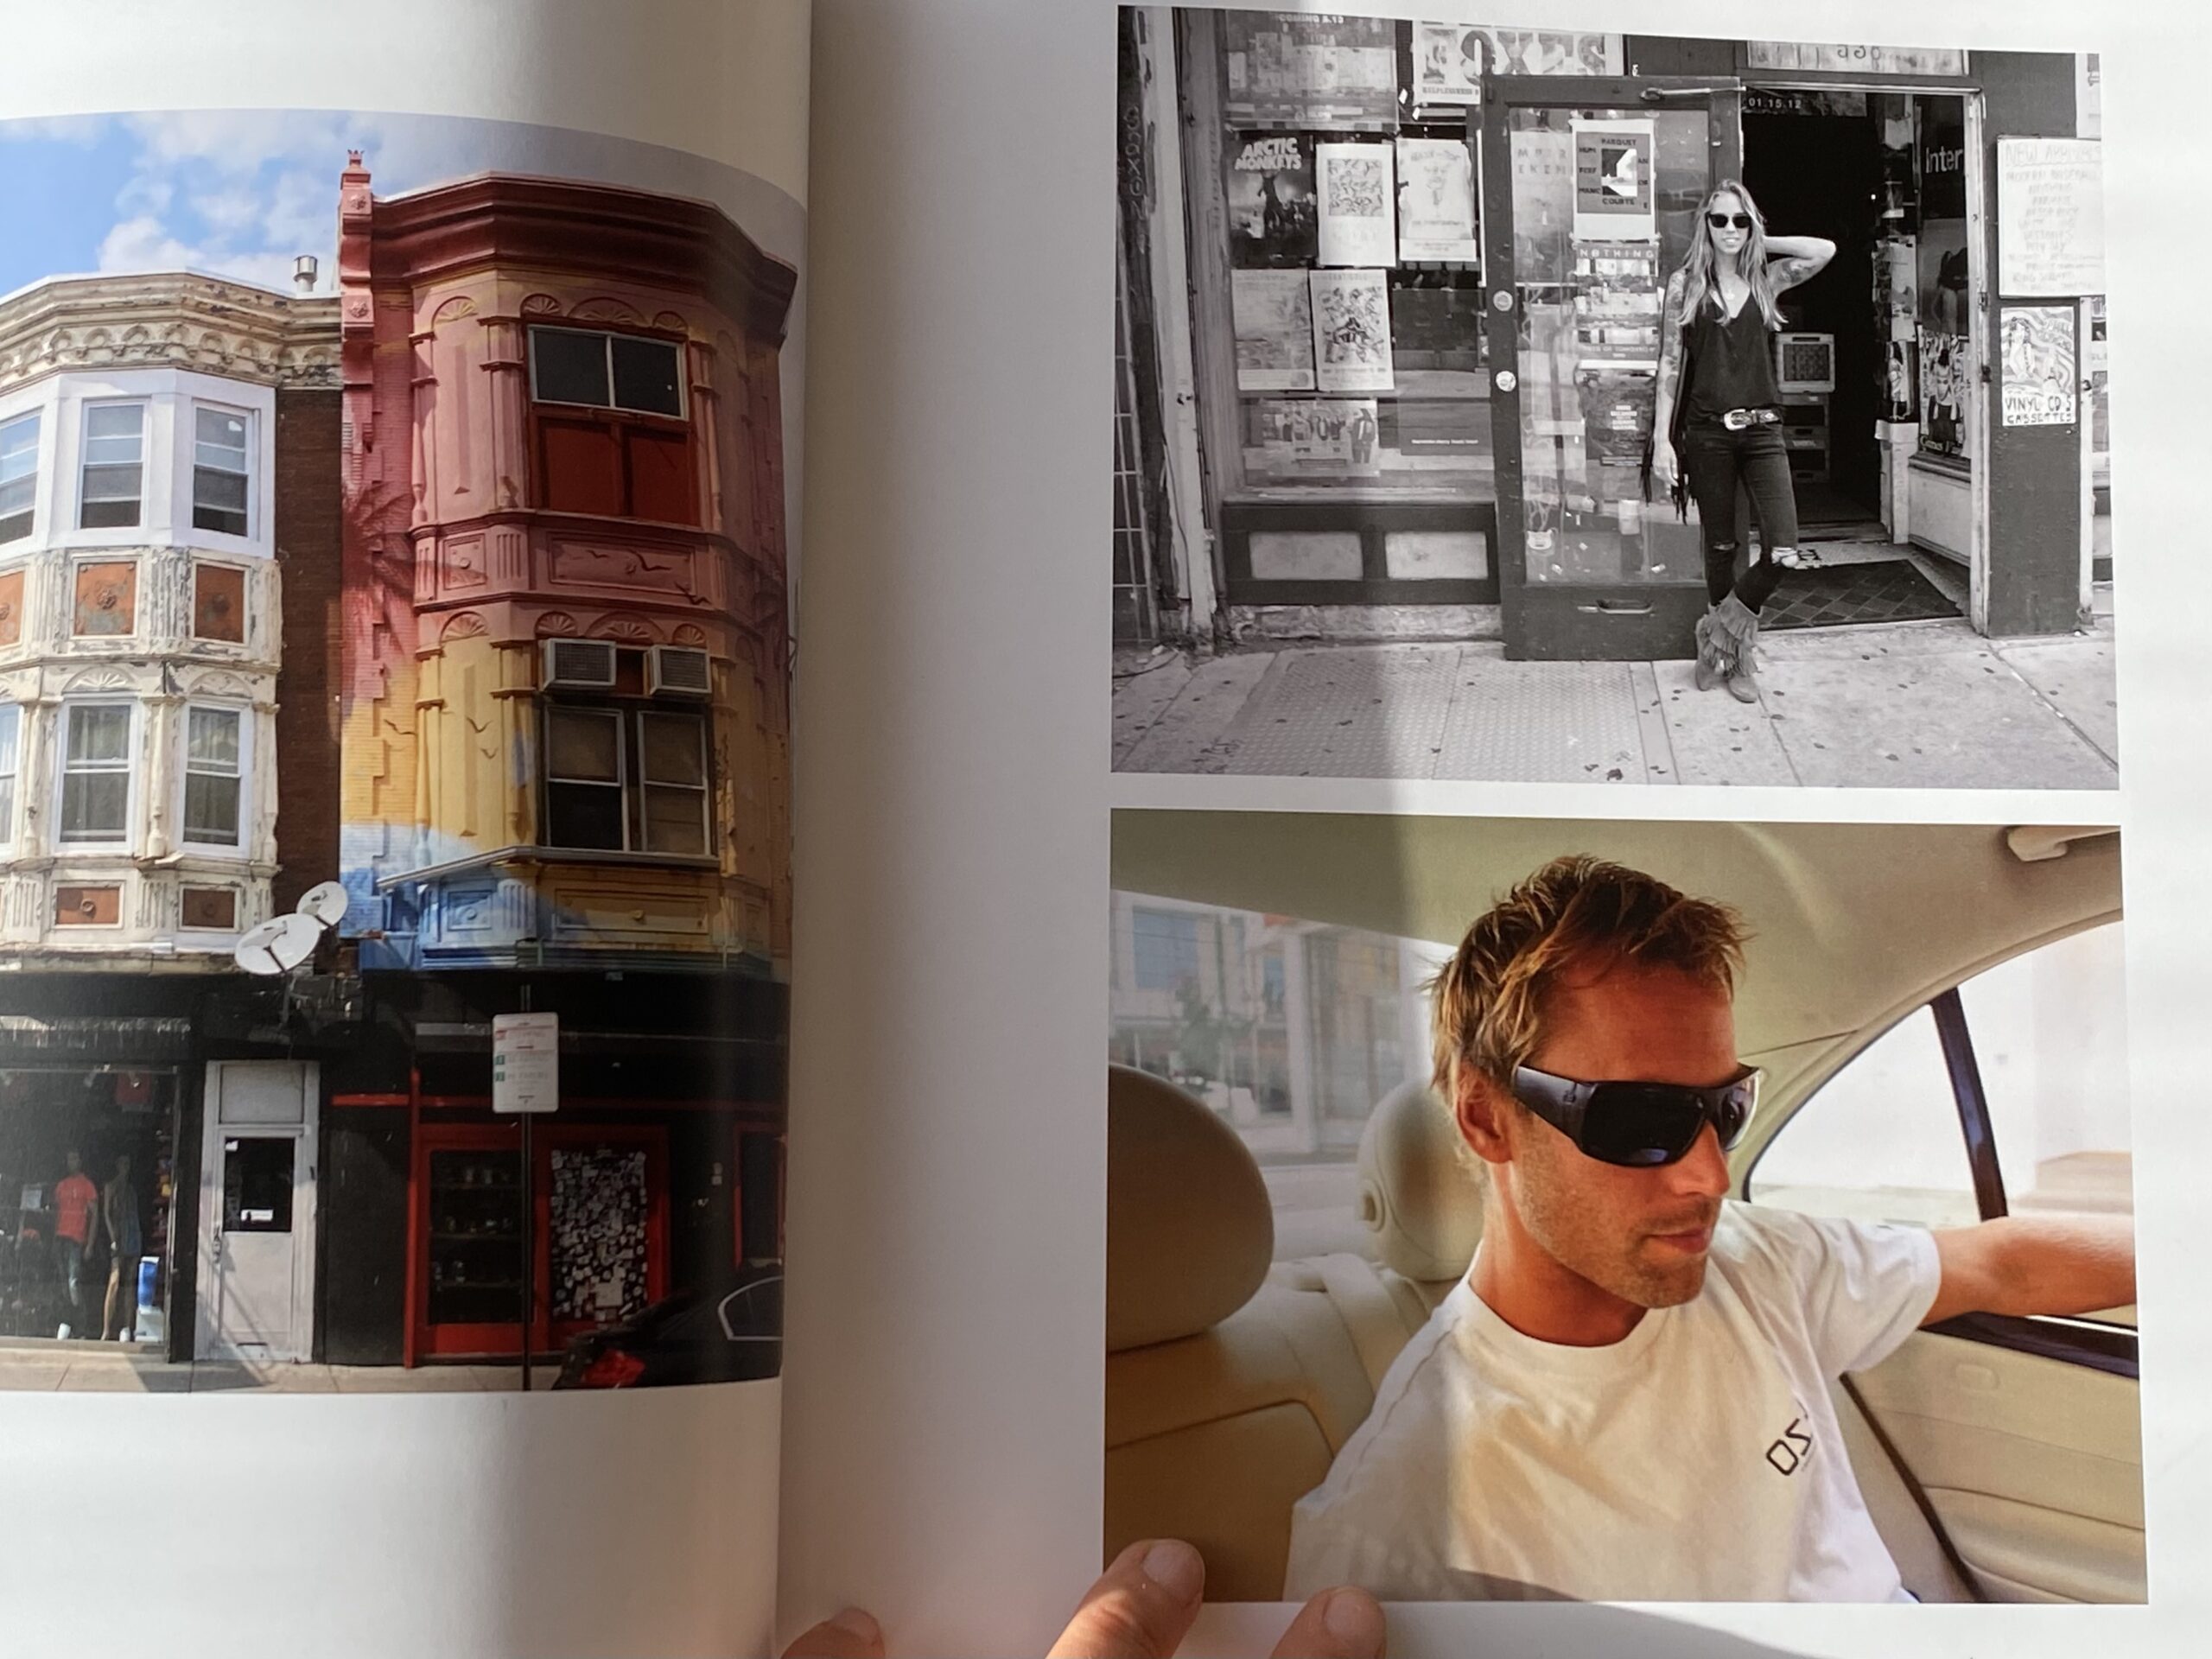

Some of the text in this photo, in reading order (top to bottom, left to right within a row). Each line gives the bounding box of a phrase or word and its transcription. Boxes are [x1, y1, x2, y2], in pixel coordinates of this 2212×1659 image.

[1240, 137, 1299, 157] ARCTIC
[1234, 153, 1302, 171] MONKEYS
[1580, 248, 1655, 259] NOTHING
[2005, 396, 2041, 412] VINYL
[2006, 412, 2072, 424] CASSETTES
